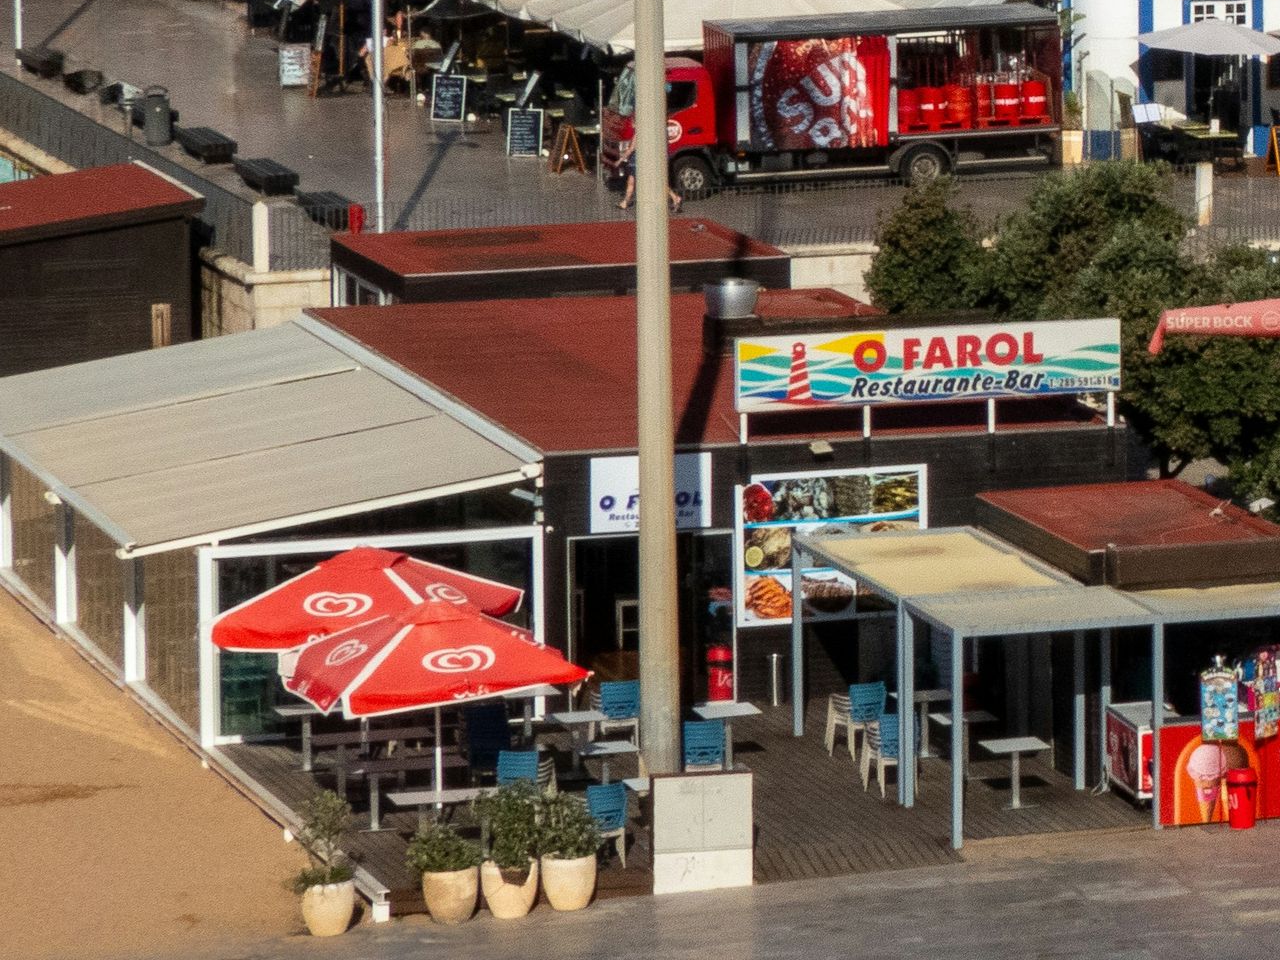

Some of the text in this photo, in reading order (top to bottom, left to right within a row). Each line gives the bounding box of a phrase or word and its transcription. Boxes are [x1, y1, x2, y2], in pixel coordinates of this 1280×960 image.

[1213, 315, 1253, 328] BOCK
[852, 331, 1044, 373] O FAROL
[851, 369, 1046, 399] Restaurante-Bar
[599, 490, 702, 511] O FOL
